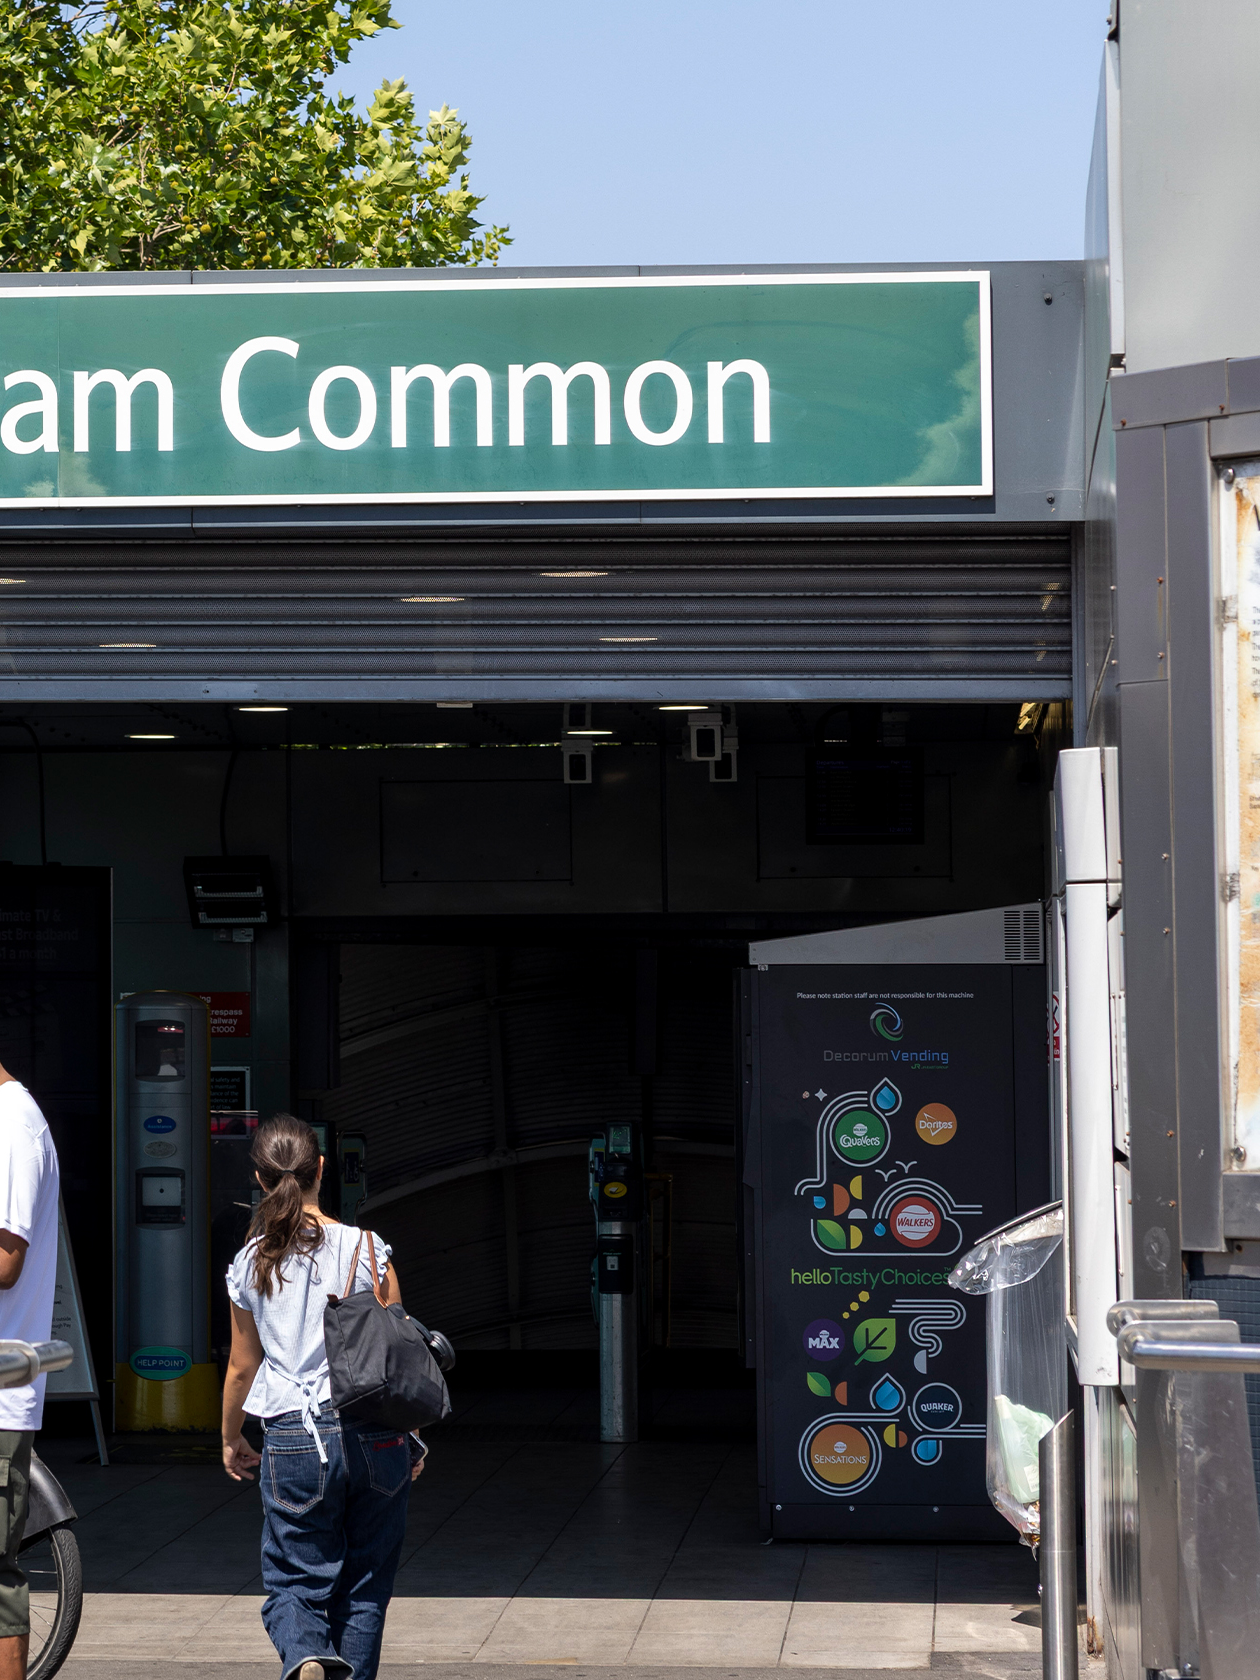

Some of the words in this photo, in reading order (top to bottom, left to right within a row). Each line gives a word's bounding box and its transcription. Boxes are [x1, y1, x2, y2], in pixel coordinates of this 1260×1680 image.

[221, 337, 770, 451] Common
[35, 909, 50, 922] TV
[53, 909, 62, 922] &
[16, 928, 78, 941] Broadband
[19, 947, 56, 960] month
[824, 1050, 888, 1062] Decorum
[891, 1050, 948, 1064] Vending
[919, 1120, 953, 1130] Doritos
[898, 1216, 934, 1226] WALKERS
[808, 1337, 840, 1349] MAX
[920, 1402, 954, 1412] QUAKER
[814, 1454, 867, 1464] SENSATIONS
